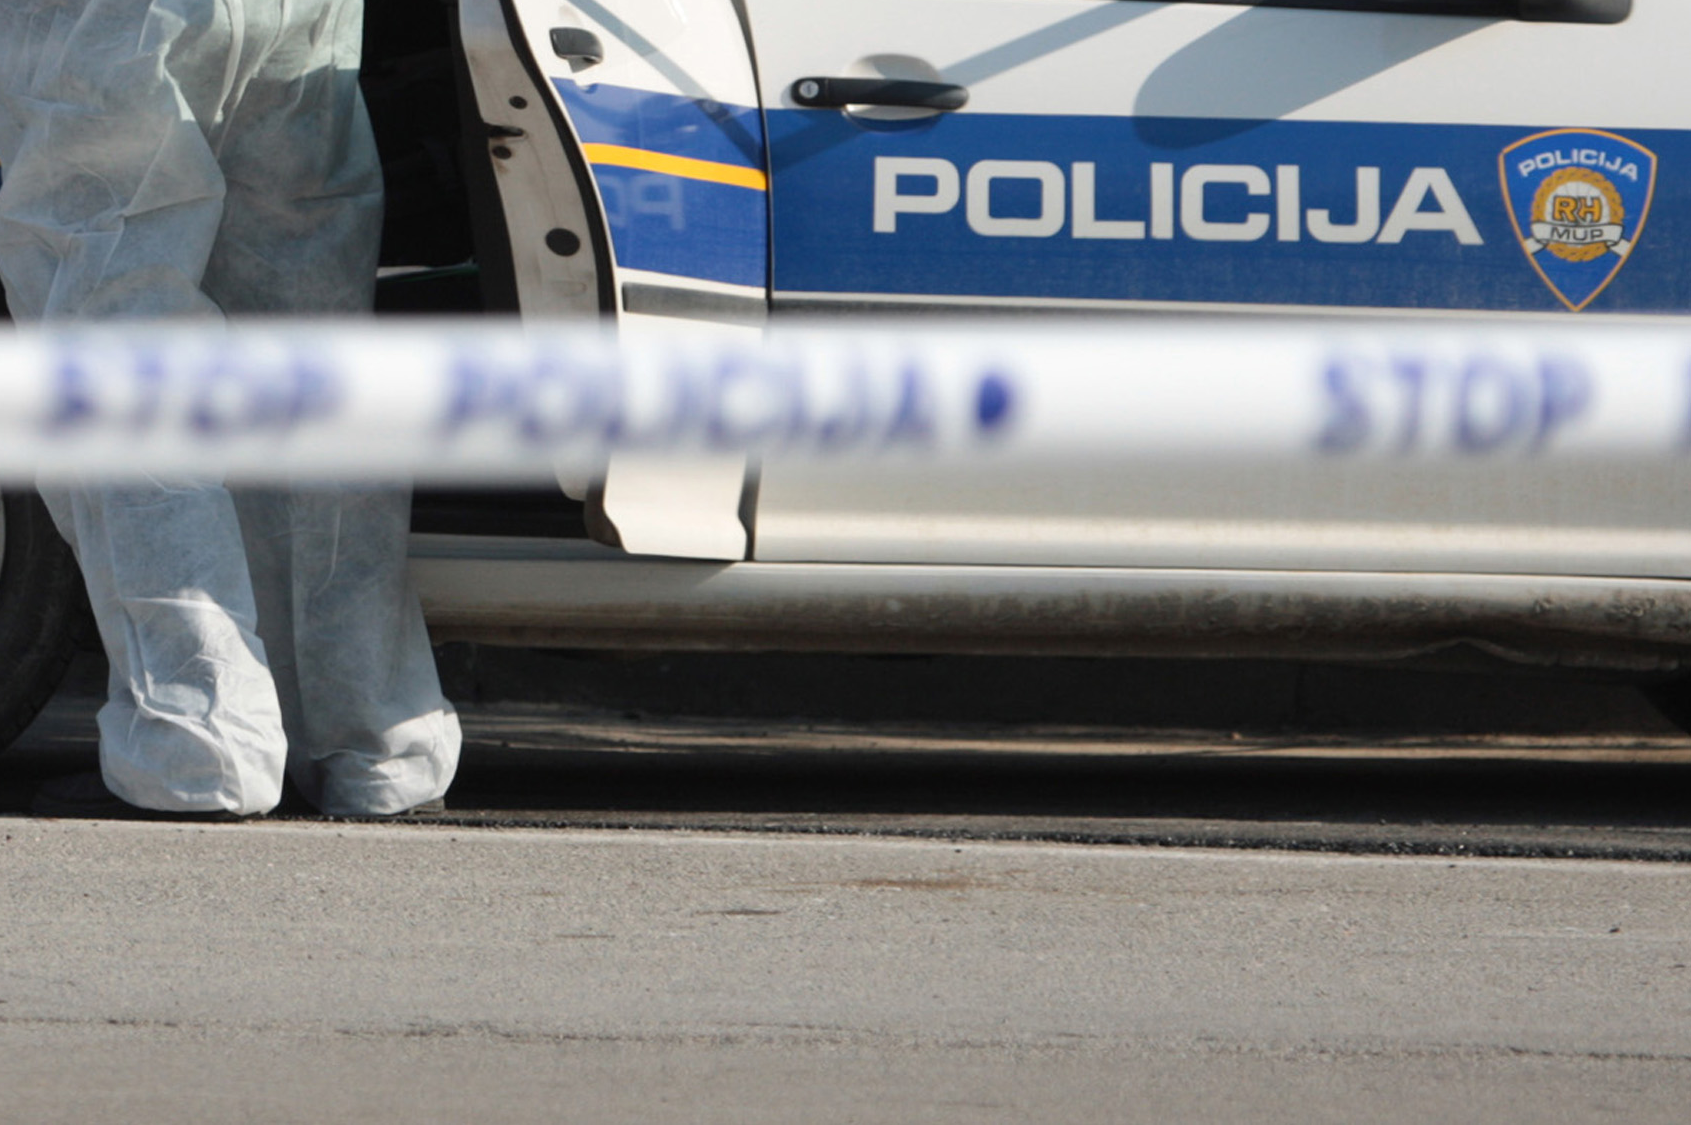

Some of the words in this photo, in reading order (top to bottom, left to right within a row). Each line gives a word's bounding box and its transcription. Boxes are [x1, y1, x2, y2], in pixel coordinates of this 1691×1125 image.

[1518, 148, 1638, 181] POLICIJA
[873, 156, 1485, 246] POLICIJA
[1552, 195, 1602, 223] RH
[1550, 226, 1604, 242] MUP
[41, 342, 346, 437] STOP
[440, 342, 938, 449] POLICIJA
[1312, 351, 1597, 455] STOP
